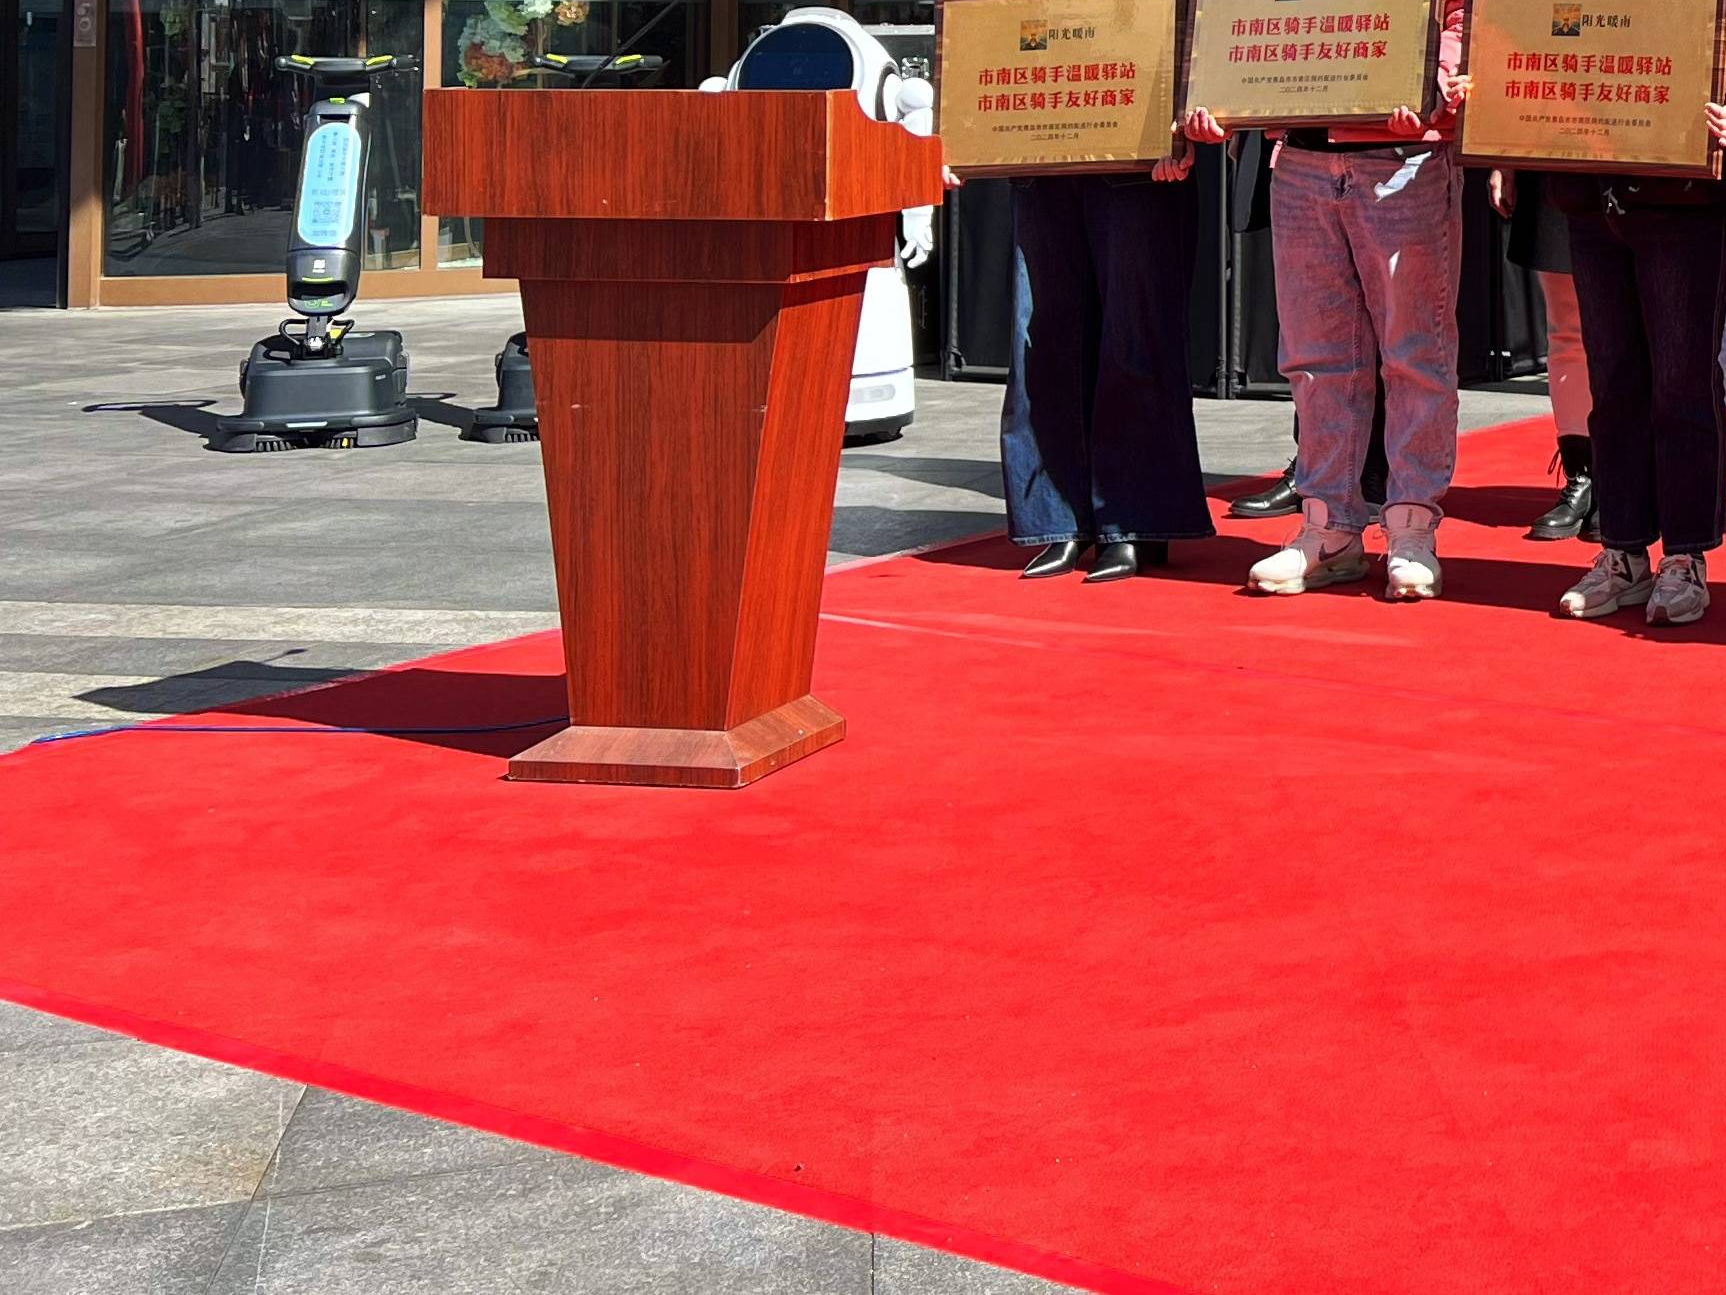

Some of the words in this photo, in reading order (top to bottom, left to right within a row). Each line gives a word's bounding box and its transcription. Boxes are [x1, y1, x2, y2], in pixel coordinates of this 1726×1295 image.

[1231, 12, 1392, 37] 市南区骑手温暖驿站
[1228, 40, 1389, 63] 市南区骑手友好商家
[1506, 51, 1673, 76] 市南区骑手温暖驿站
[978, 61, 1137, 87] 市南区骑手温暖驿站
[977, 88, 1136, 112] 市南区骑手友好商家
[1504, 79, 1671, 104] 市南区骑手友好商家
